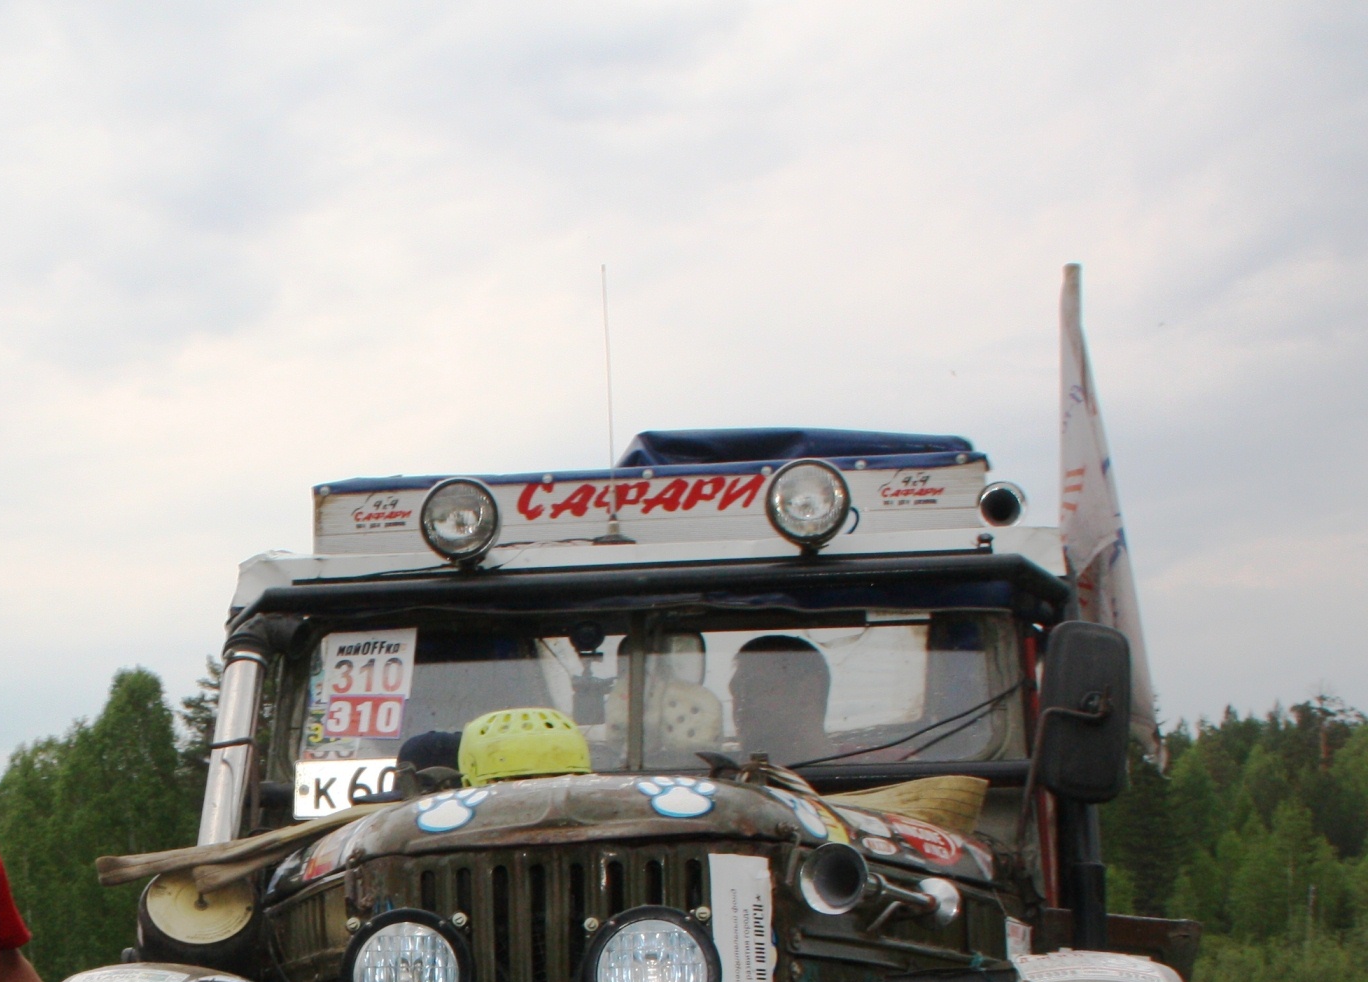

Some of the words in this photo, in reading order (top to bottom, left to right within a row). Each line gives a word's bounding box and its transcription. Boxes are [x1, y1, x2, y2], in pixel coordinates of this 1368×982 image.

[517, 474, 766, 521] САФАРИ
[332, 658, 403, 694] 310
[326, 700, 402, 733] 310
[742, 908, 751, 938] города
[743, 940, 753, 980] развития
